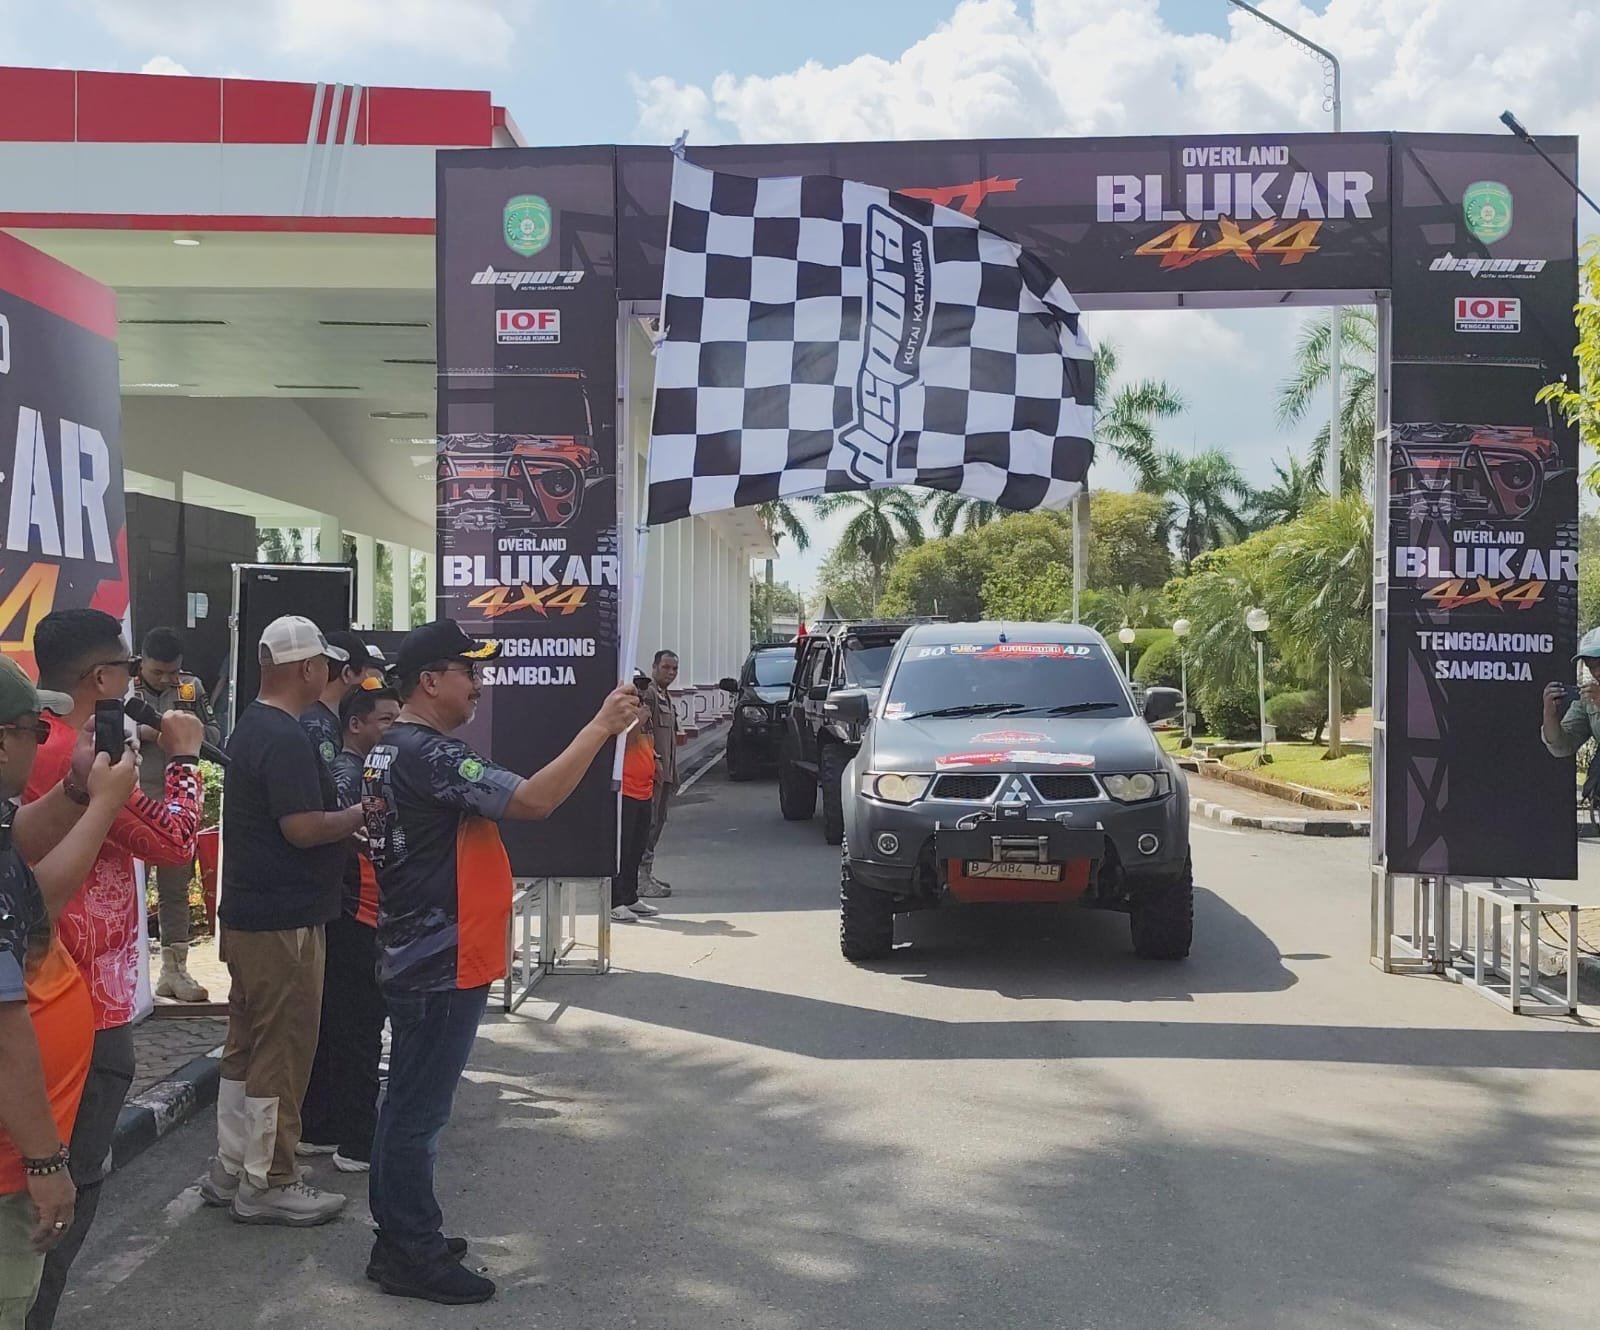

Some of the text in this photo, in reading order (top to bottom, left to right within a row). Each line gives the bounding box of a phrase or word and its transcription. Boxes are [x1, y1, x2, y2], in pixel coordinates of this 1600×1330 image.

[1182, 146, 1289, 167] OVERLAND
[1097, 171, 1374, 223] BLUKAR
[1429, 252, 1547, 279] dispora
[471, 264, 585, 291] dispora
[1458, 300, 1516, 318] IOF
[500, 312, 556, 330] IOF
[903, 327, 921, 365] KUTAI
[498, 538, 567, 551] OVERLAND
[1453, 530, 1524, 544] OVERLAND
[443, 555, 618, 586] BLUKAR
[1395, 546, 1578, 581] BLUKAR
[474, 638, 596, 657] GGARONG
[1416, 631, 1553, 653] TENGGARONG
[483, 666, 577, 685] SAMBOJA
[1435, 660, 1533, 681] SAMBOJA
[972, 862, 979, 872] B
